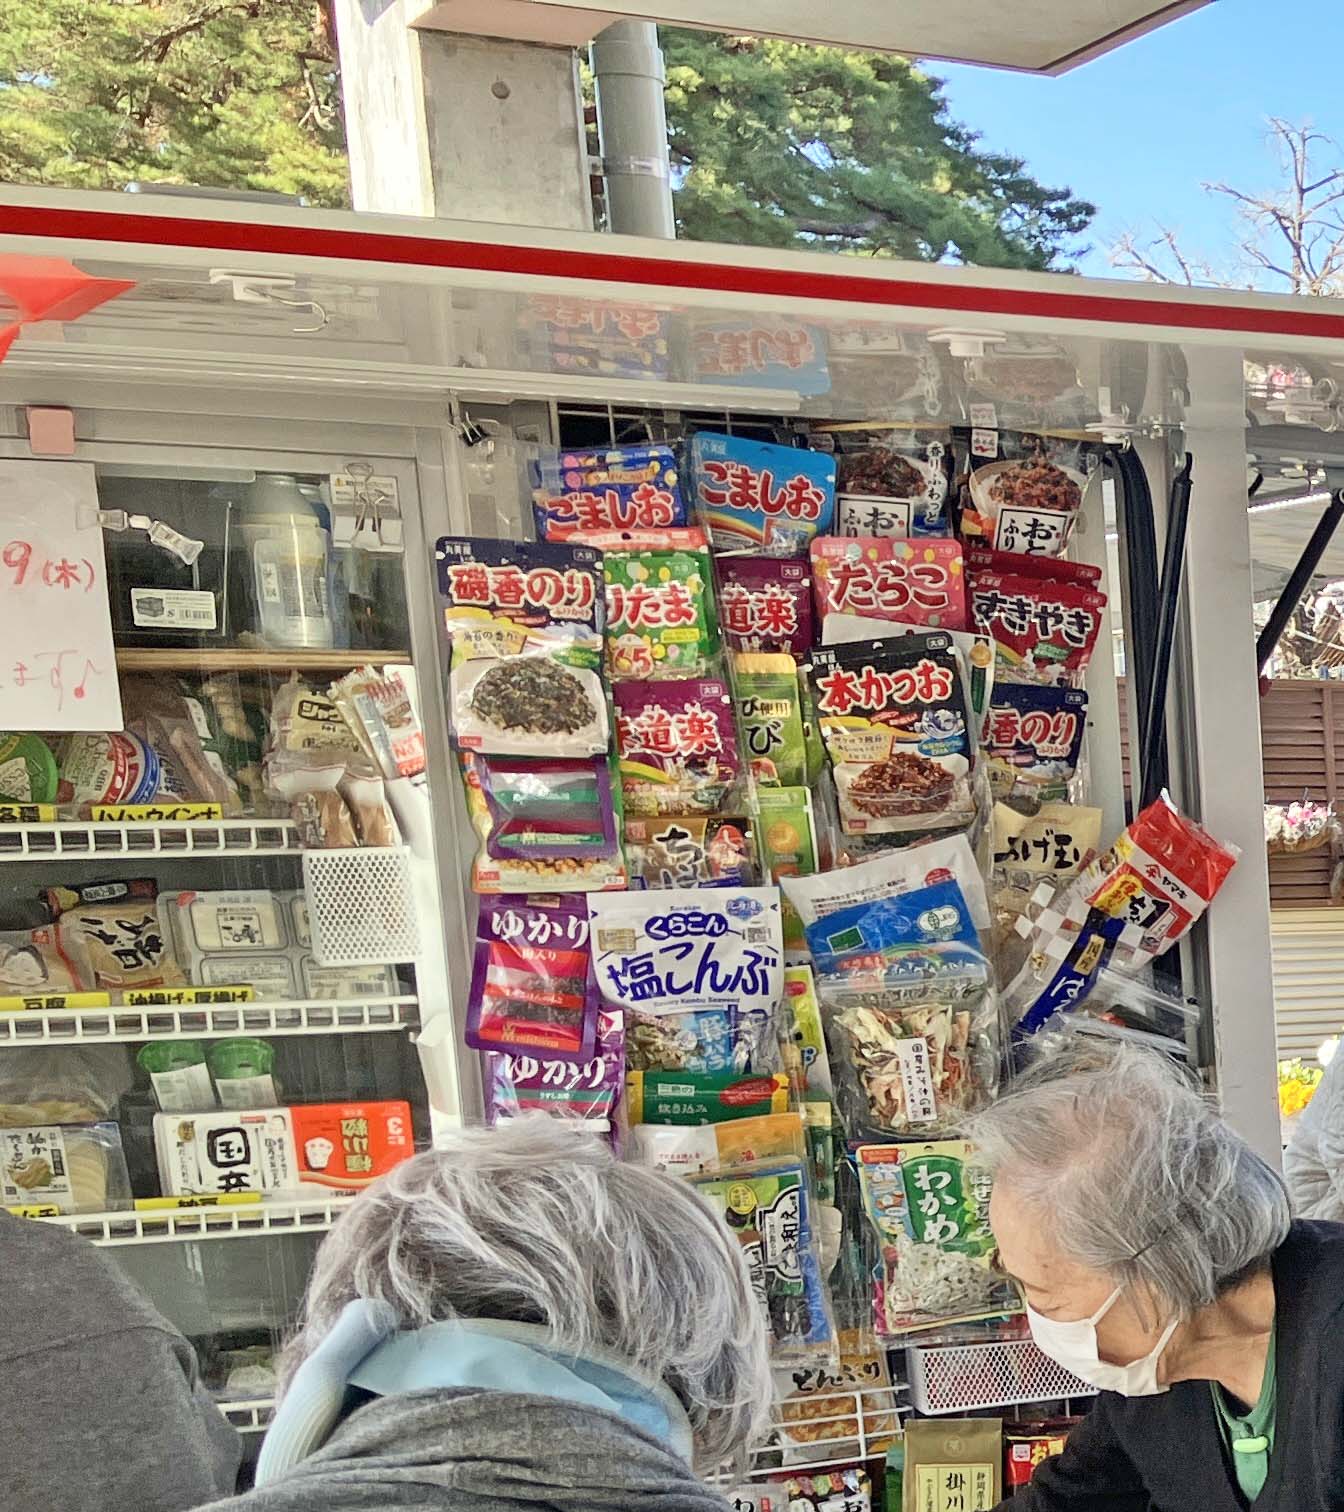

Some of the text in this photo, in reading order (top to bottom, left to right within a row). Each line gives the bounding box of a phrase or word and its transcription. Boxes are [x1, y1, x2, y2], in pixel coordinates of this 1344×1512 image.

[547, 483, 675, 531] ごましお
[699, 462, 825, 520] ごましお
[448, 563, 595, 609] 磯香のり
[828, 562, 948, 611] たらこ
[974, 590, 1092, 646] すきやき
[817, 660, 953, 714] 本かつお
[1162, 876, 1188, 900] ヤマキ
[491, 909, 590, 949] ゆかり
[649, 914, 727, 938] くらこん
[607, 942, 777, 1001] 塩こんぶ
[504, 1055, 606, 1089] ゆかり
[913, 1164, 960, 1244] わかめ
